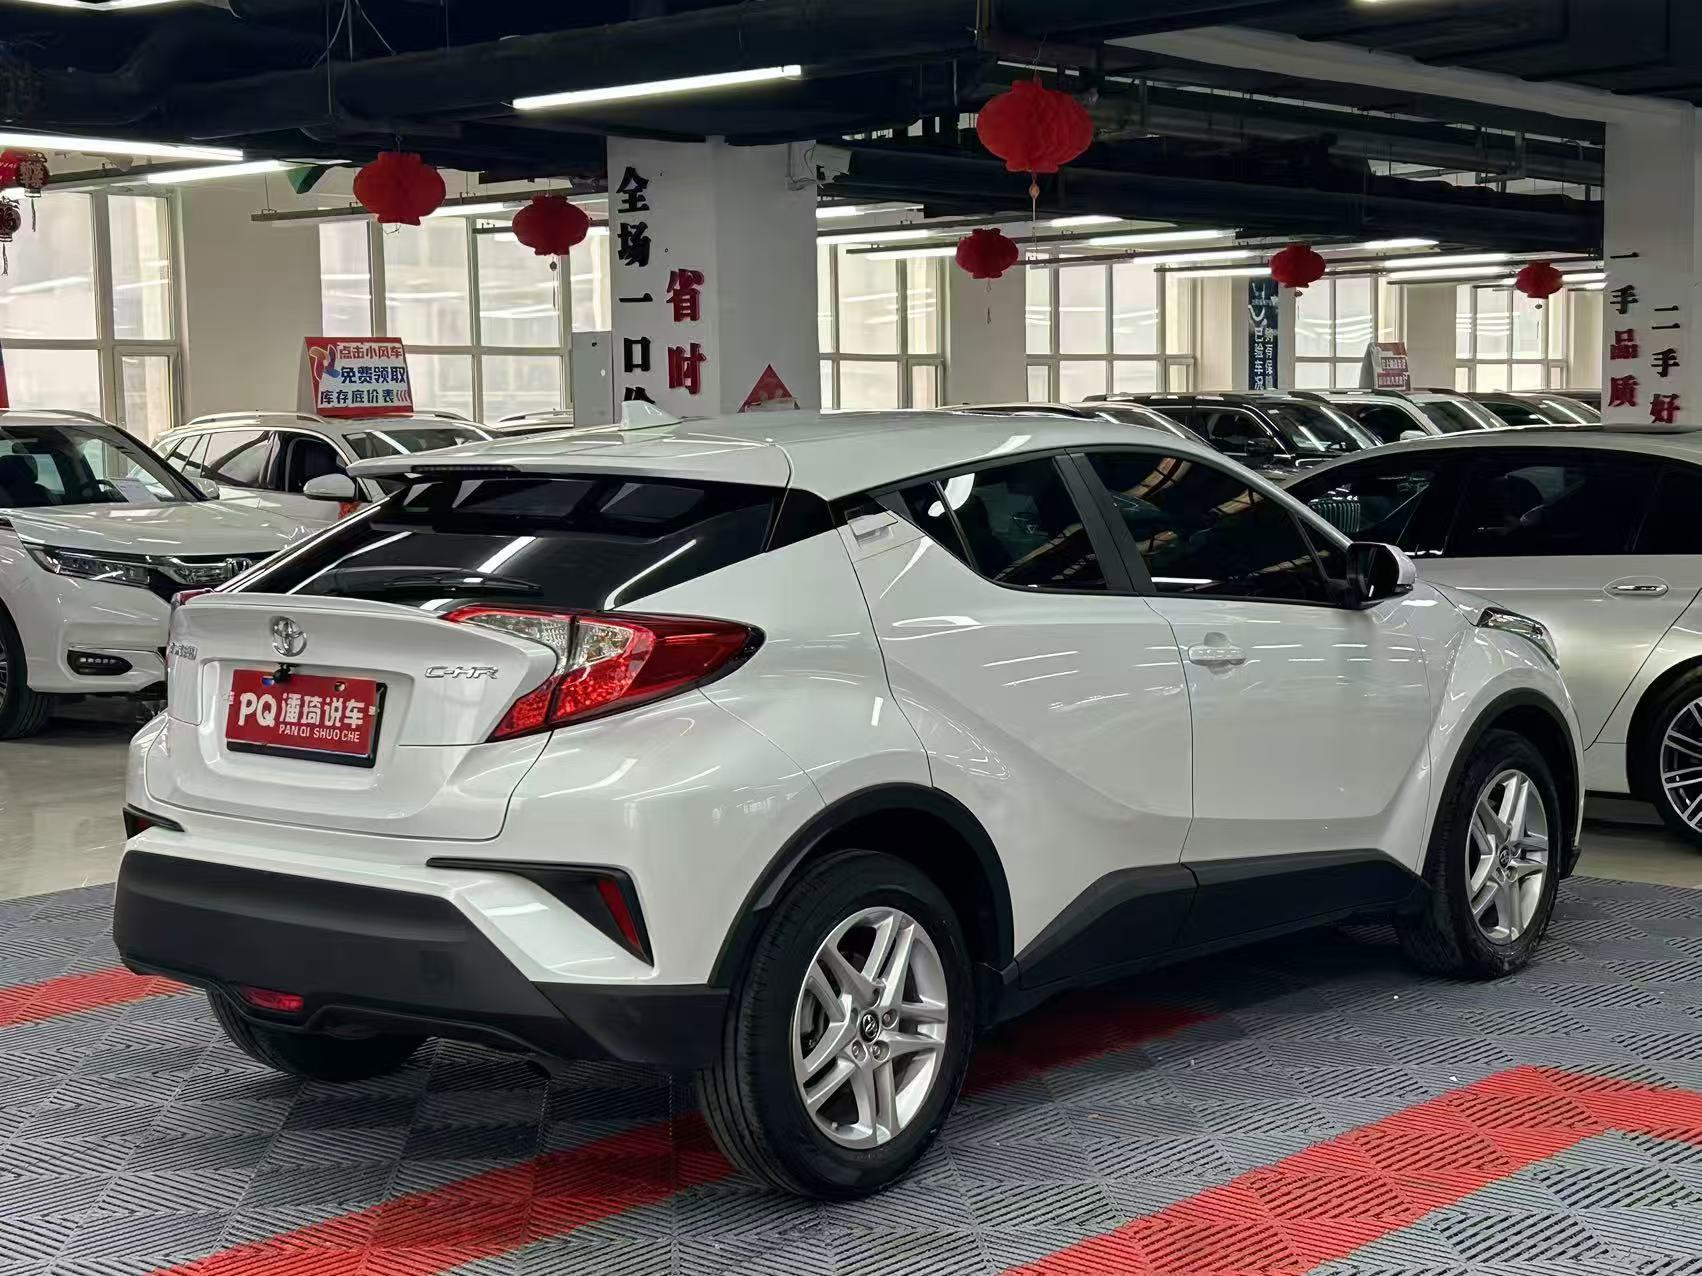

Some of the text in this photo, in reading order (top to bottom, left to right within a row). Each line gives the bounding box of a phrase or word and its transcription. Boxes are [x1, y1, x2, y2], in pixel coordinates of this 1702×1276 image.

[666, 268, 707, 395] 省时
[1608, 252, 1640, 407] 一手品质
[339, 345, 402, 359] 点击小风车
[1650, 305, 1681, 424] 二手好
[341, 366, 406, 384] 免费领取
[320, 389, 394, 404] 库存底价表
[425, 665, 499, 681] C-HR
[238, 692, 277, 727] PQ
[280, 693, 365, 729] 潘琦说车
[279, 724, 360, 742] PAN QI SHUO CHE
